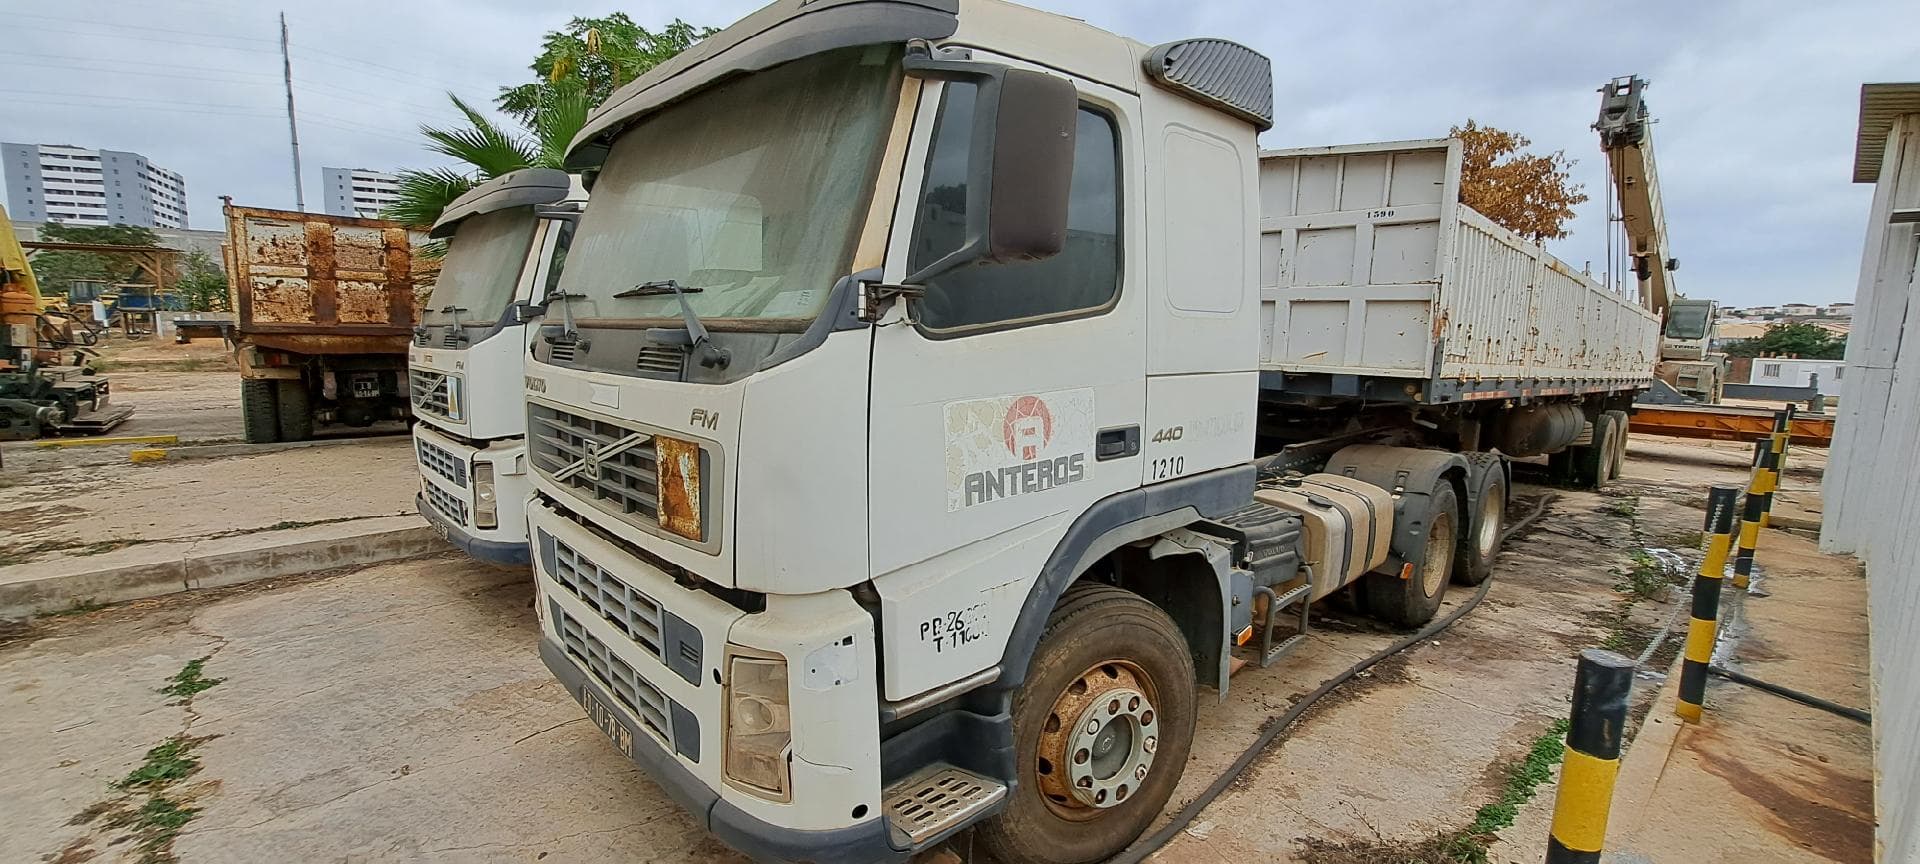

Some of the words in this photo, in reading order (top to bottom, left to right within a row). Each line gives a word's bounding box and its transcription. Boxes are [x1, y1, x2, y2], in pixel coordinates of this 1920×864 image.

[1367, 210, 1395, 219] 1590
[690, 408, 719, 431] FM
[1151, 426, 1184, 444] 440
[964, 452, 1085, 507] ANTEROS
[1151, 456, 1185, 480] 1210
